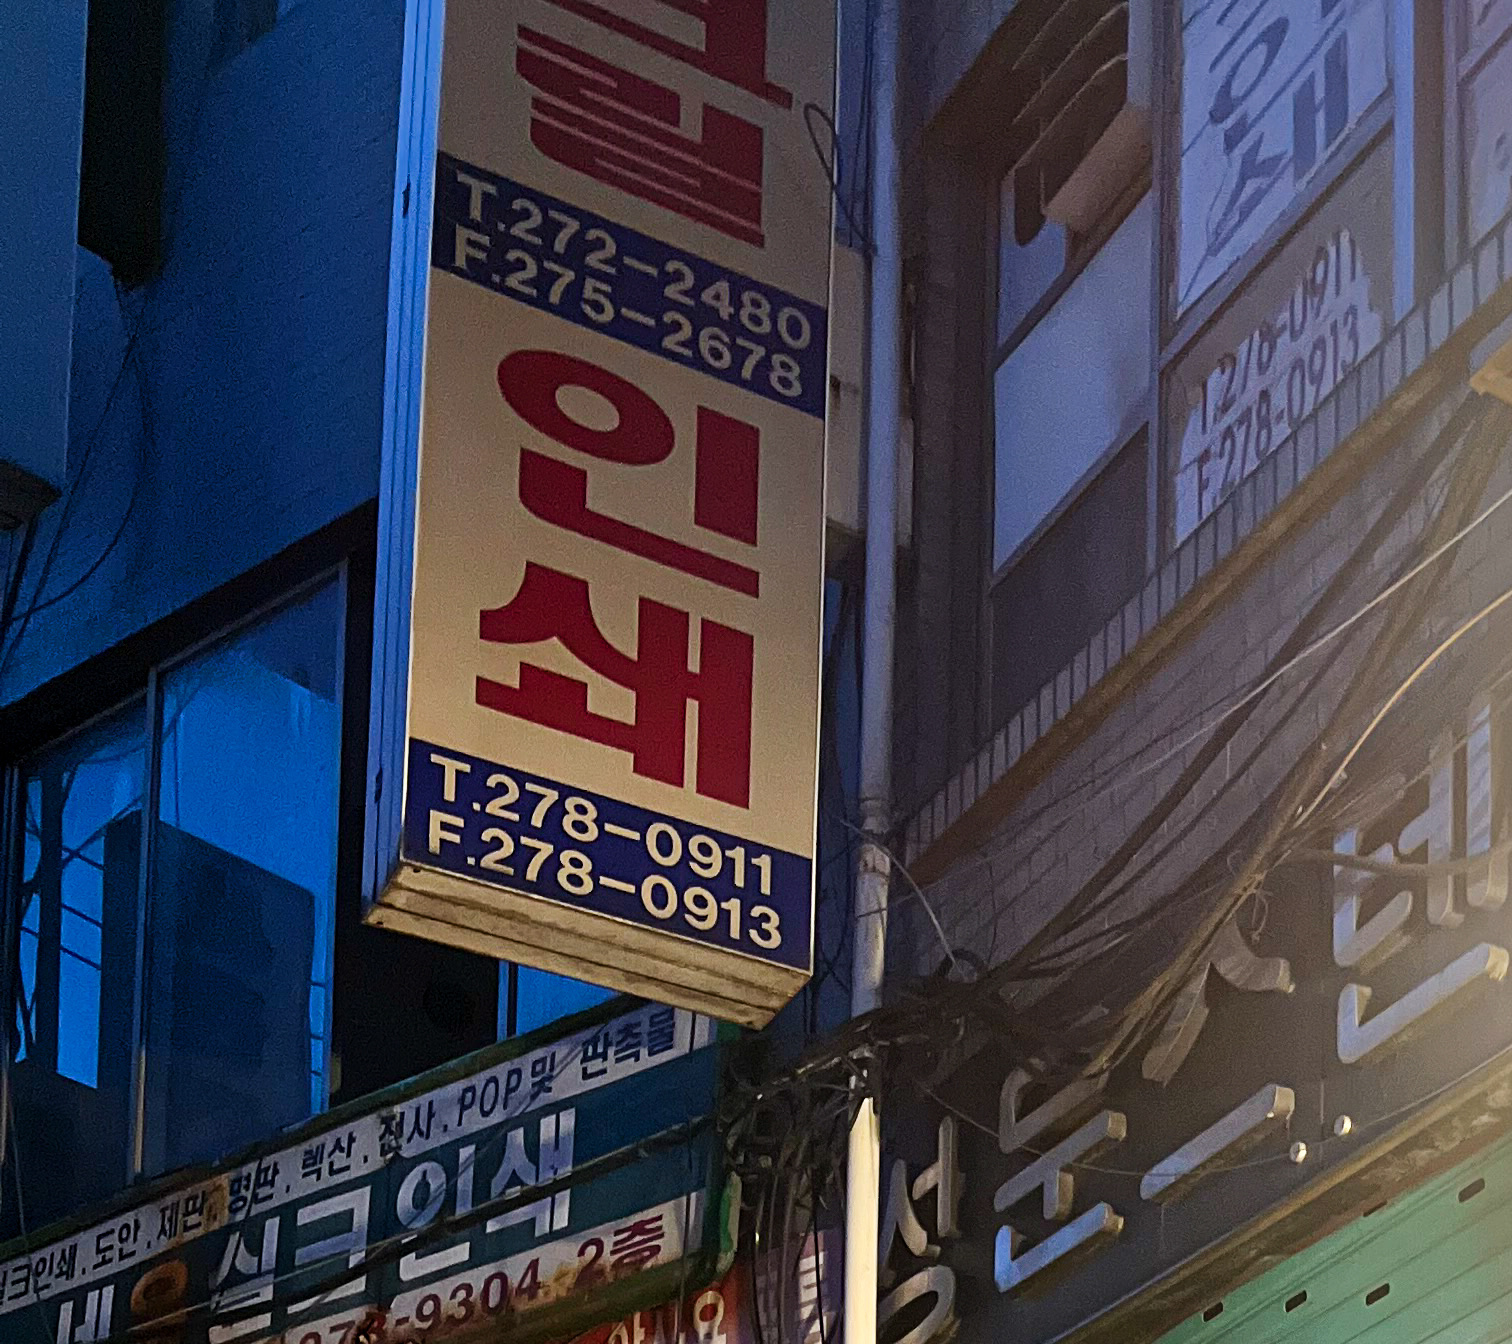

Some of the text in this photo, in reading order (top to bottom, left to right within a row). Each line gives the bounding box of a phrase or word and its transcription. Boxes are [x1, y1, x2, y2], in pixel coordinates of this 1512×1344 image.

[454, 223, 802, 397] F.275-2678
[457, 170, 811, 350] T.272-2480
[476, 349, 760, 809] 인쇄
[427, 809, 782, 950] F.278-0913
[430, 753, 773, 895] T.278-0911
